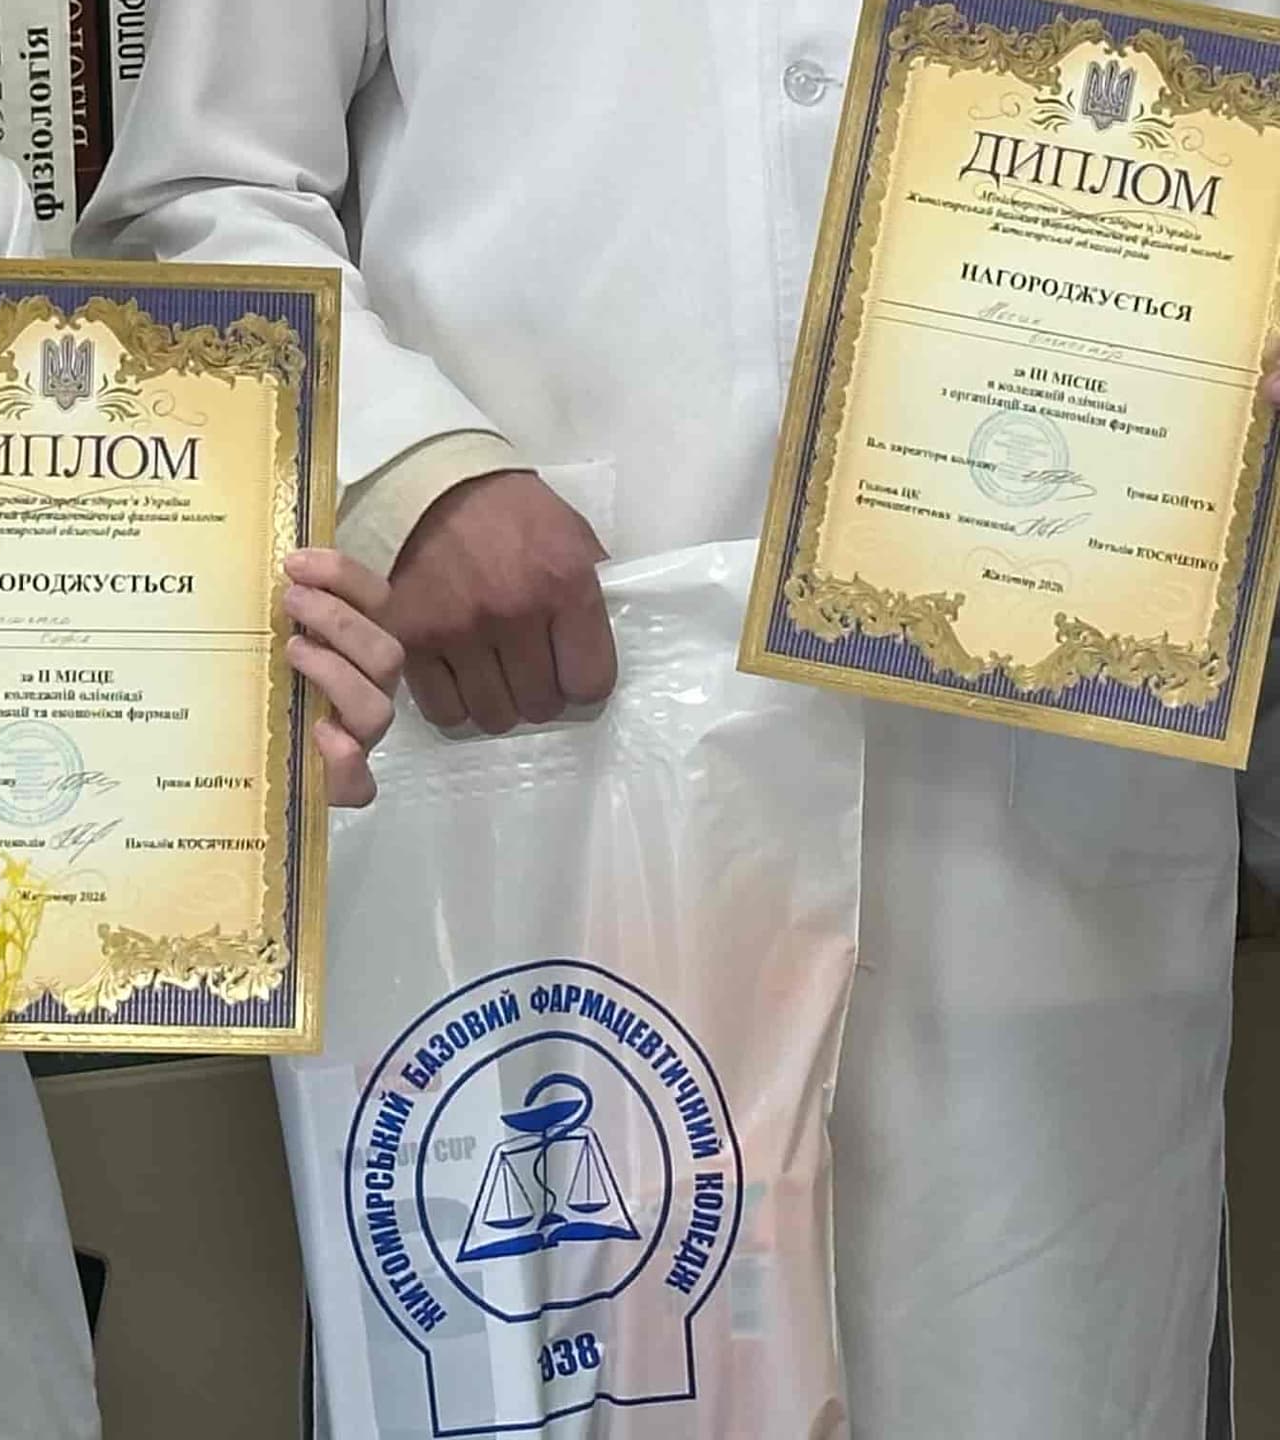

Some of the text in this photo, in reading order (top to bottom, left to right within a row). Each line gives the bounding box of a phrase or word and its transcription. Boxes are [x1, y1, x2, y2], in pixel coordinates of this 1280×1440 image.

[20, 27, 65, 221] фізіологія
[958, 130, 1223, 218] ДИПЛОМ
[960, 262, 1194, 322] НАГОРОДЖУЄТЬСЯ
[56, 669, 115, 686] МІСЦЕ
[365, 983, 725, 1333] ЖИТОМИРСЬКИЙ БАЗОВИЙ ФАРМАЦЕВТИЧНИЙ КОЛЕДЖ
